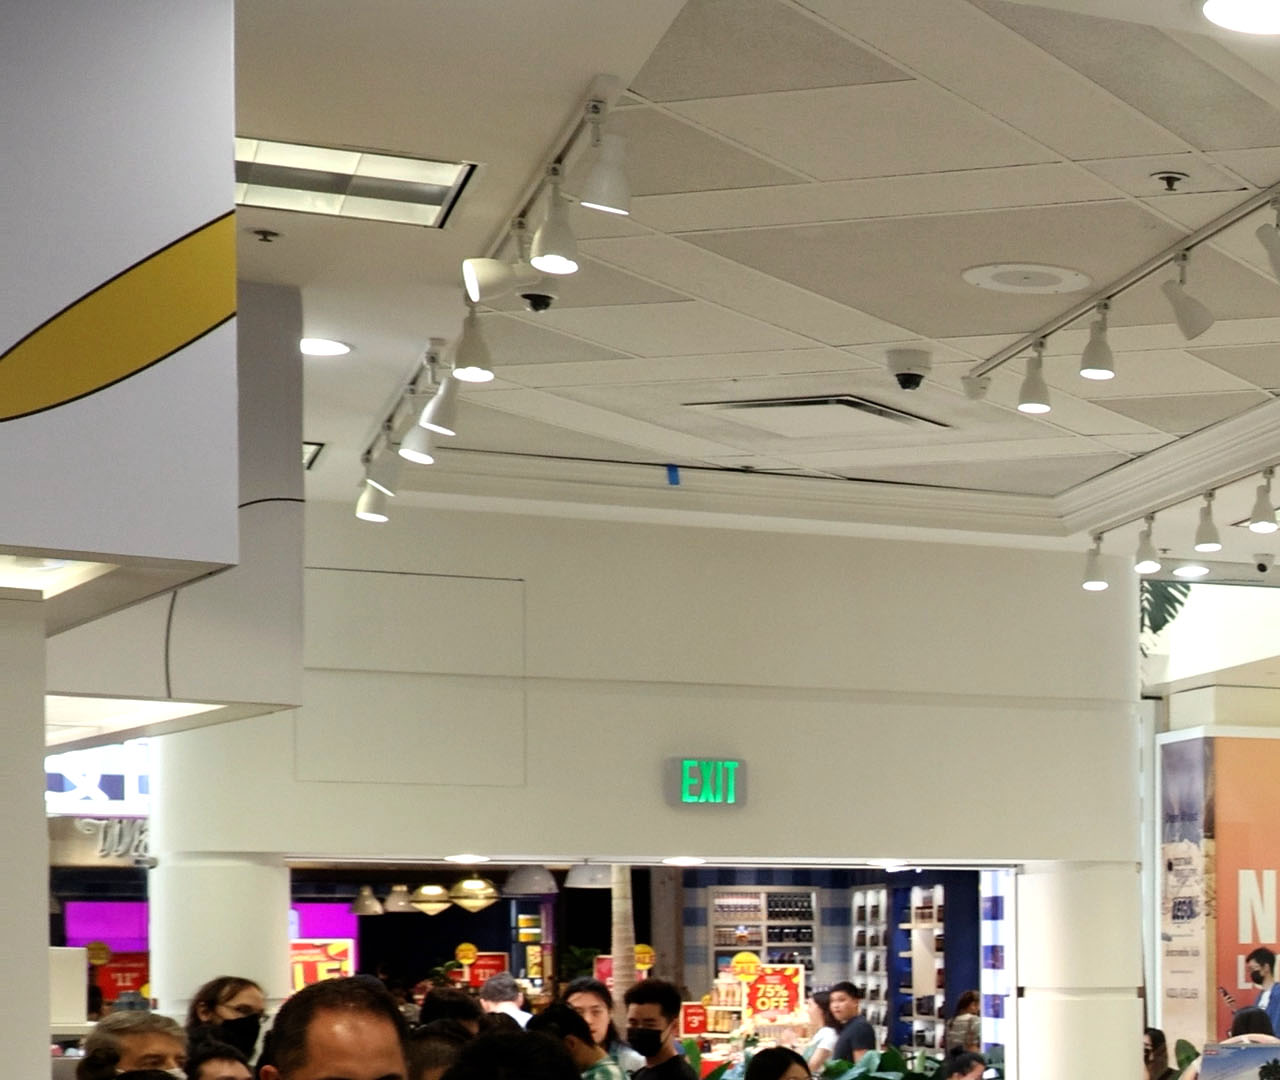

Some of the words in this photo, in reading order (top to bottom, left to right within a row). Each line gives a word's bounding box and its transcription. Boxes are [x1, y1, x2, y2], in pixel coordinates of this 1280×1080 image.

[682, 760, 739, 803] EXIT
[756, 984, 789, 998] 75%
[756, 998, 788, 1010] OFF
